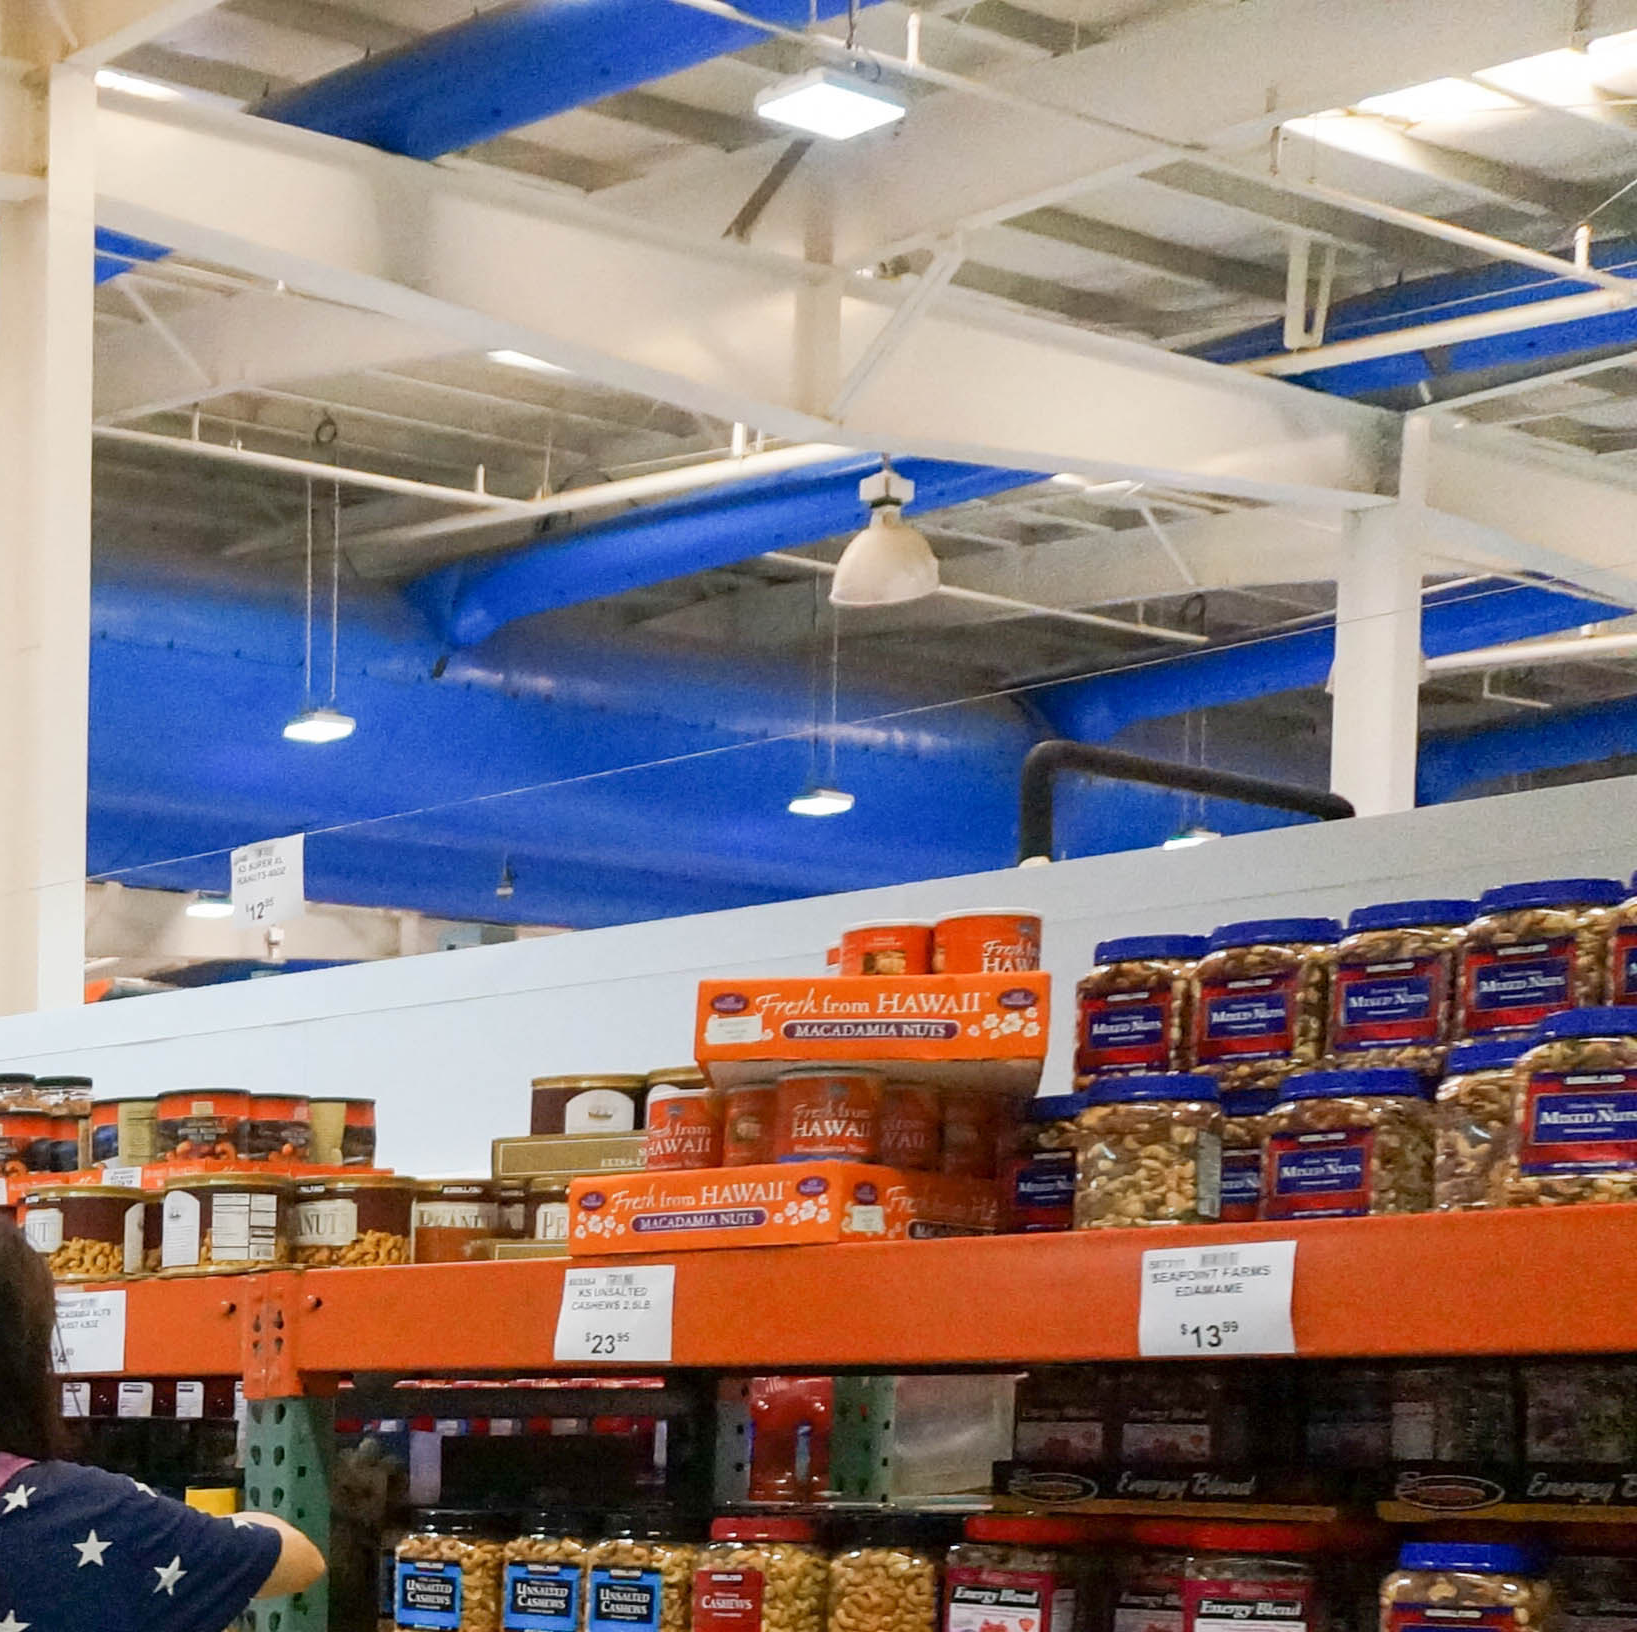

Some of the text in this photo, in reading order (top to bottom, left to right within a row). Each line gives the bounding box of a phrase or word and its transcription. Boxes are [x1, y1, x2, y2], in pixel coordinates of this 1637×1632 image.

[755, 987, 982, 1016] Fresh from HAWAII
[795, 1021, 946, 1038] MACADAMIA NUTS
[611, 1181, 785, 1213] Fresh from HAWAII
[639, 1209, 756, 1231] MACADAMIA NUTS
